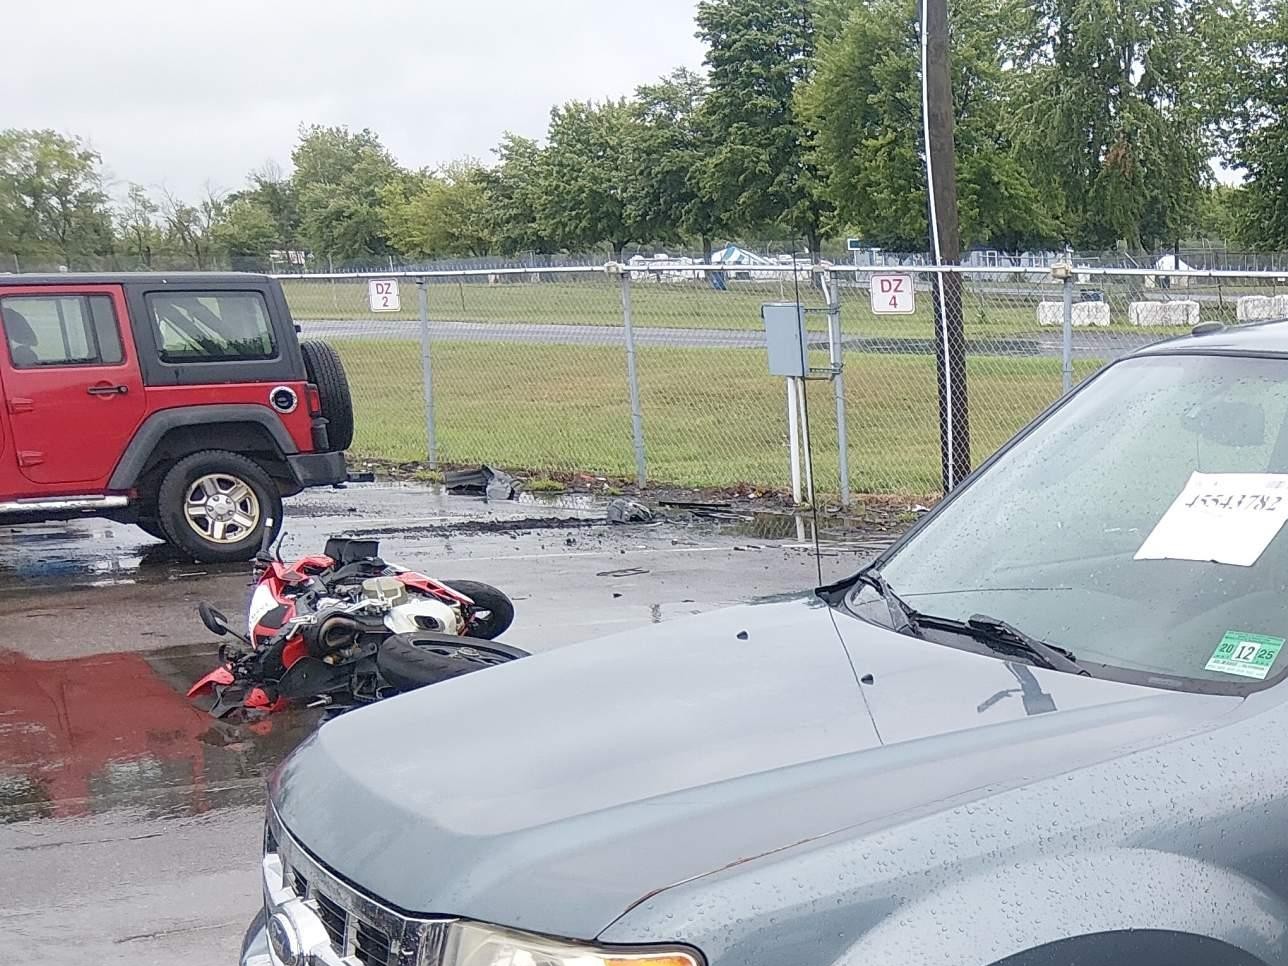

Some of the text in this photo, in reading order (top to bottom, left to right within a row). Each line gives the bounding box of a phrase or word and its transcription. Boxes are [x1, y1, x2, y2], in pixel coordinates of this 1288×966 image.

[375, 282, 392, 295] DZ
[880, 278, 904, 293] DZ
[382, 296, 389, 307] 2
[888, 295, 898, 309] 4
[1219, 643, 1275, 661] 20 12 25
